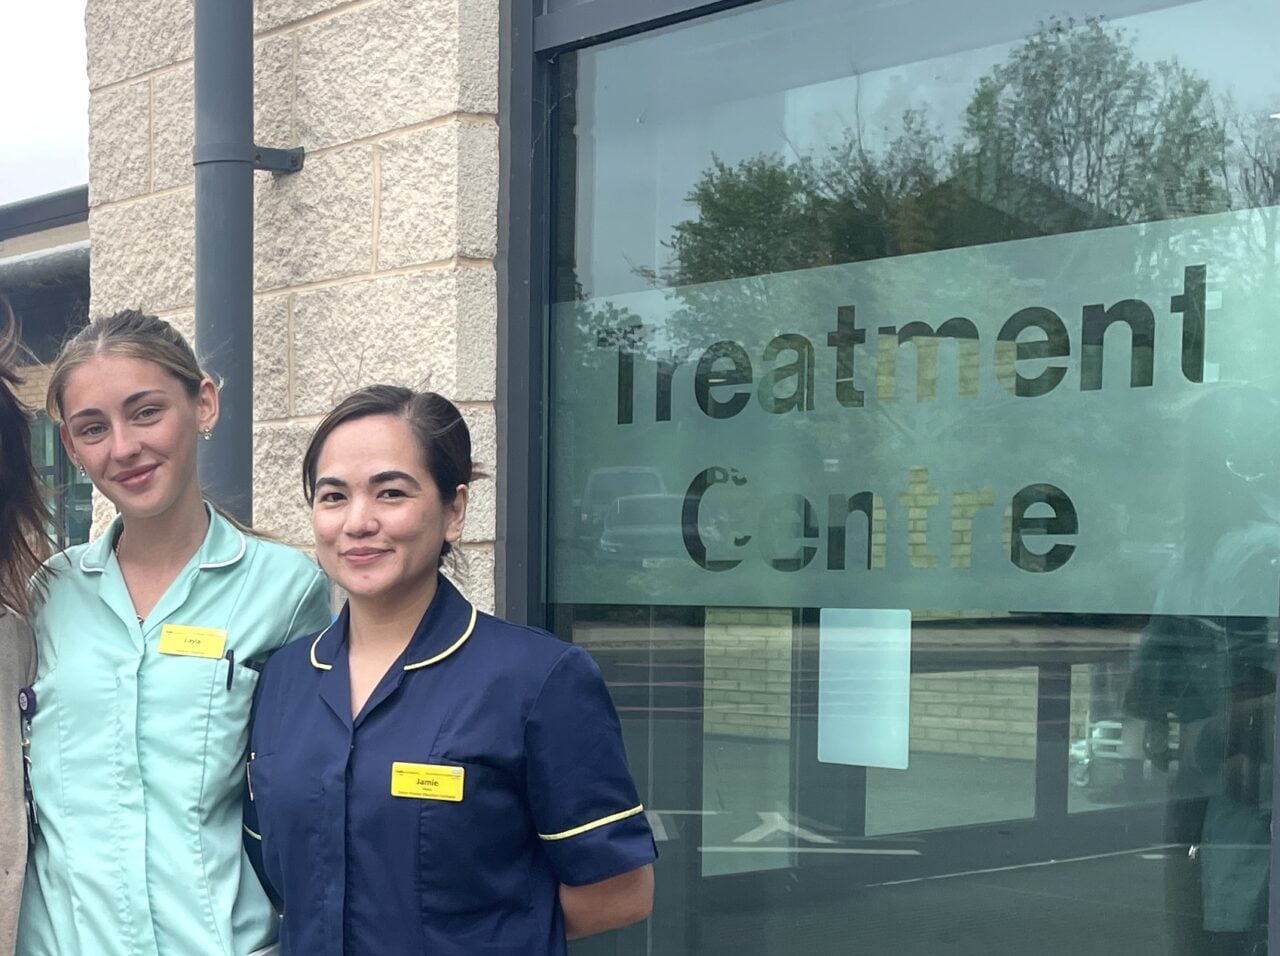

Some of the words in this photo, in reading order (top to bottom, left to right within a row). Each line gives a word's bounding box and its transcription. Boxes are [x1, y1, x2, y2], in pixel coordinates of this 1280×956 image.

[596, 264, 1207, 425] Treatment
[681, 465, 1079, 573] Centre
[416, 778, 439, 787] Jamie
